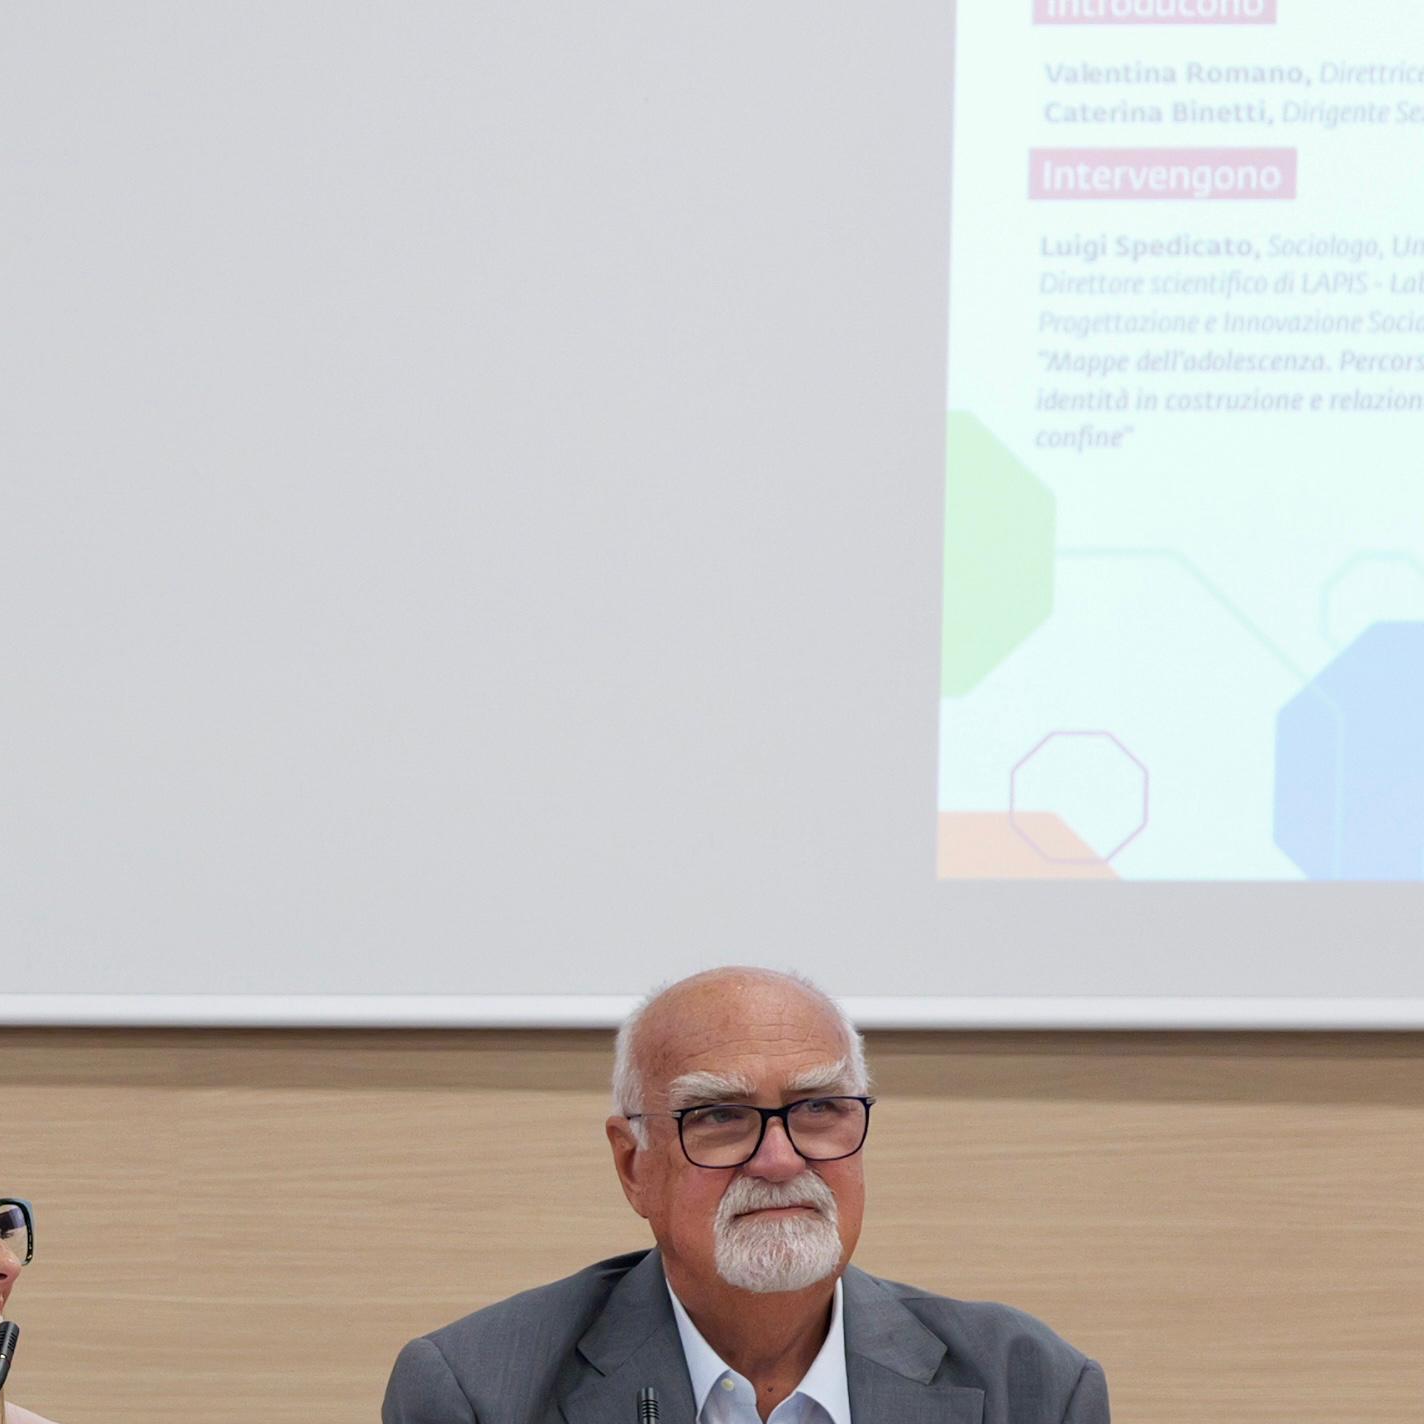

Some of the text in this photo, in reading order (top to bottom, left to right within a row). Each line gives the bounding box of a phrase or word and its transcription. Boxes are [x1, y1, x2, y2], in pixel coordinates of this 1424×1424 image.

[1043, 61, 1177, 85] Valentina
[1184, 62, 1312, 88] Romano,
[1042, 99, 1163, 124] Caterina
[1172, 98, 1275, 126] Binetti,
[1282, 99, 1391, 129] Dirigente
[1042, 160, 1283, 198] Intervengono
[1041, 234, 1108, 263] Luigi
[1115, 234, 1262, 263] Spedicato,
[1268, 234, 1384, 263] Sociologo,
[1040, 272, 1144, 296] Direttore
[1150, 270, 1267, 299] scientifico
[1273, 272, 1296, 296] di
[1301, 273, 1369, 296] LAPIS
[1039, 311, 1200, 340] Progettazione
[1204, 317, 1218, 334] e
[1223, 311, 1363, 334] Innovazione
[1136, 349, 1330, 372] dell'adolescenza.
[1036, 387, 1130, 412] identità
[1136, 388, 1158, 410] in
[1164, 388, 1304, 411] costruzione
[1310, 394, 1323, 411] e
[1034, 423, 1135, 454] confine"
